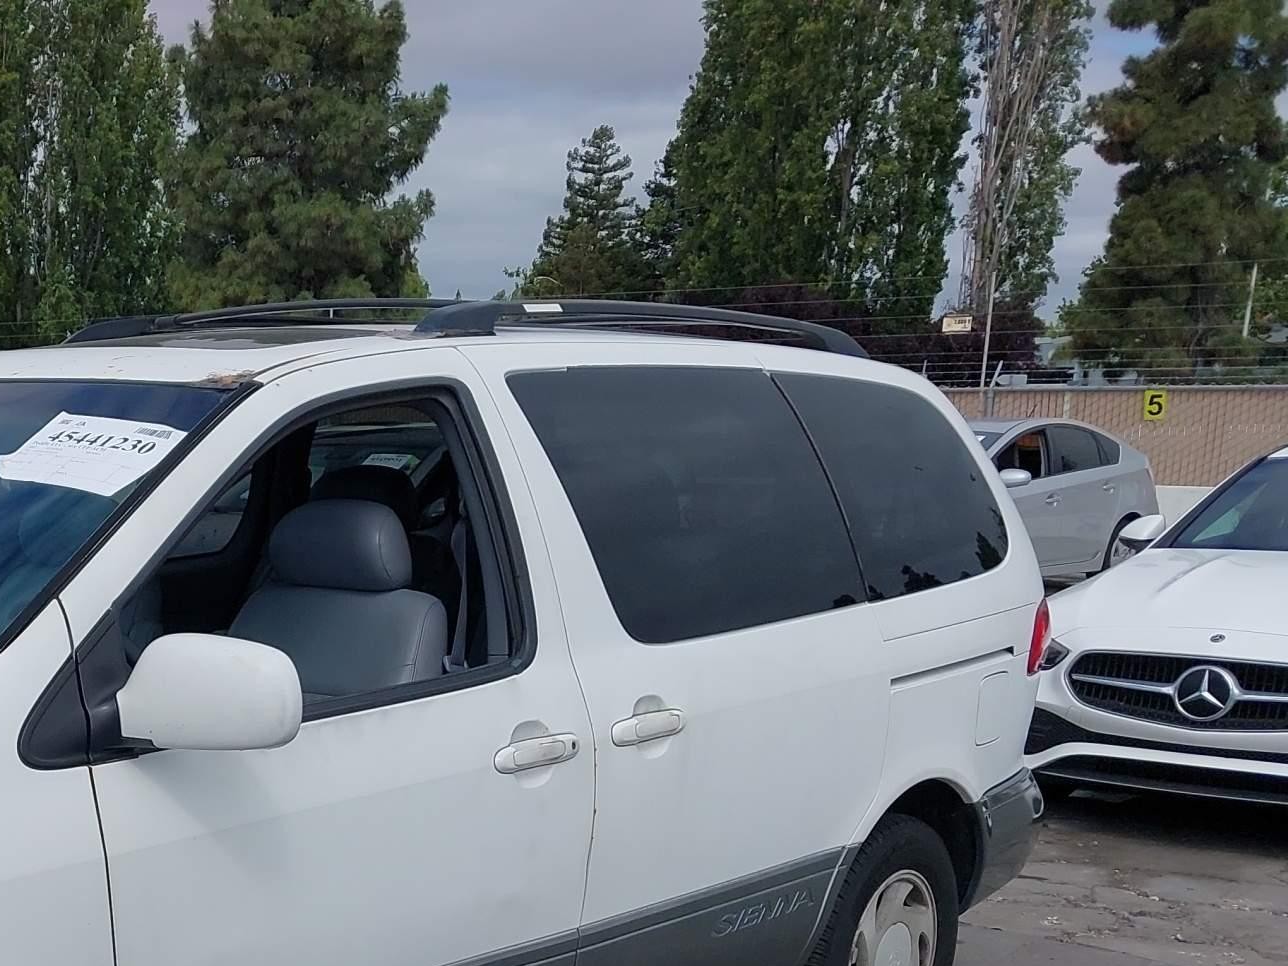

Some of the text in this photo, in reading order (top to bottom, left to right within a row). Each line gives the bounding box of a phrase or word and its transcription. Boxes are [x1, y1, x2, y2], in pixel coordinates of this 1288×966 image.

[1147, 393, 1164, 416] 5
[48, 430, 157, 455] 45441230
[712, 890, 815, 936] SIENNA
